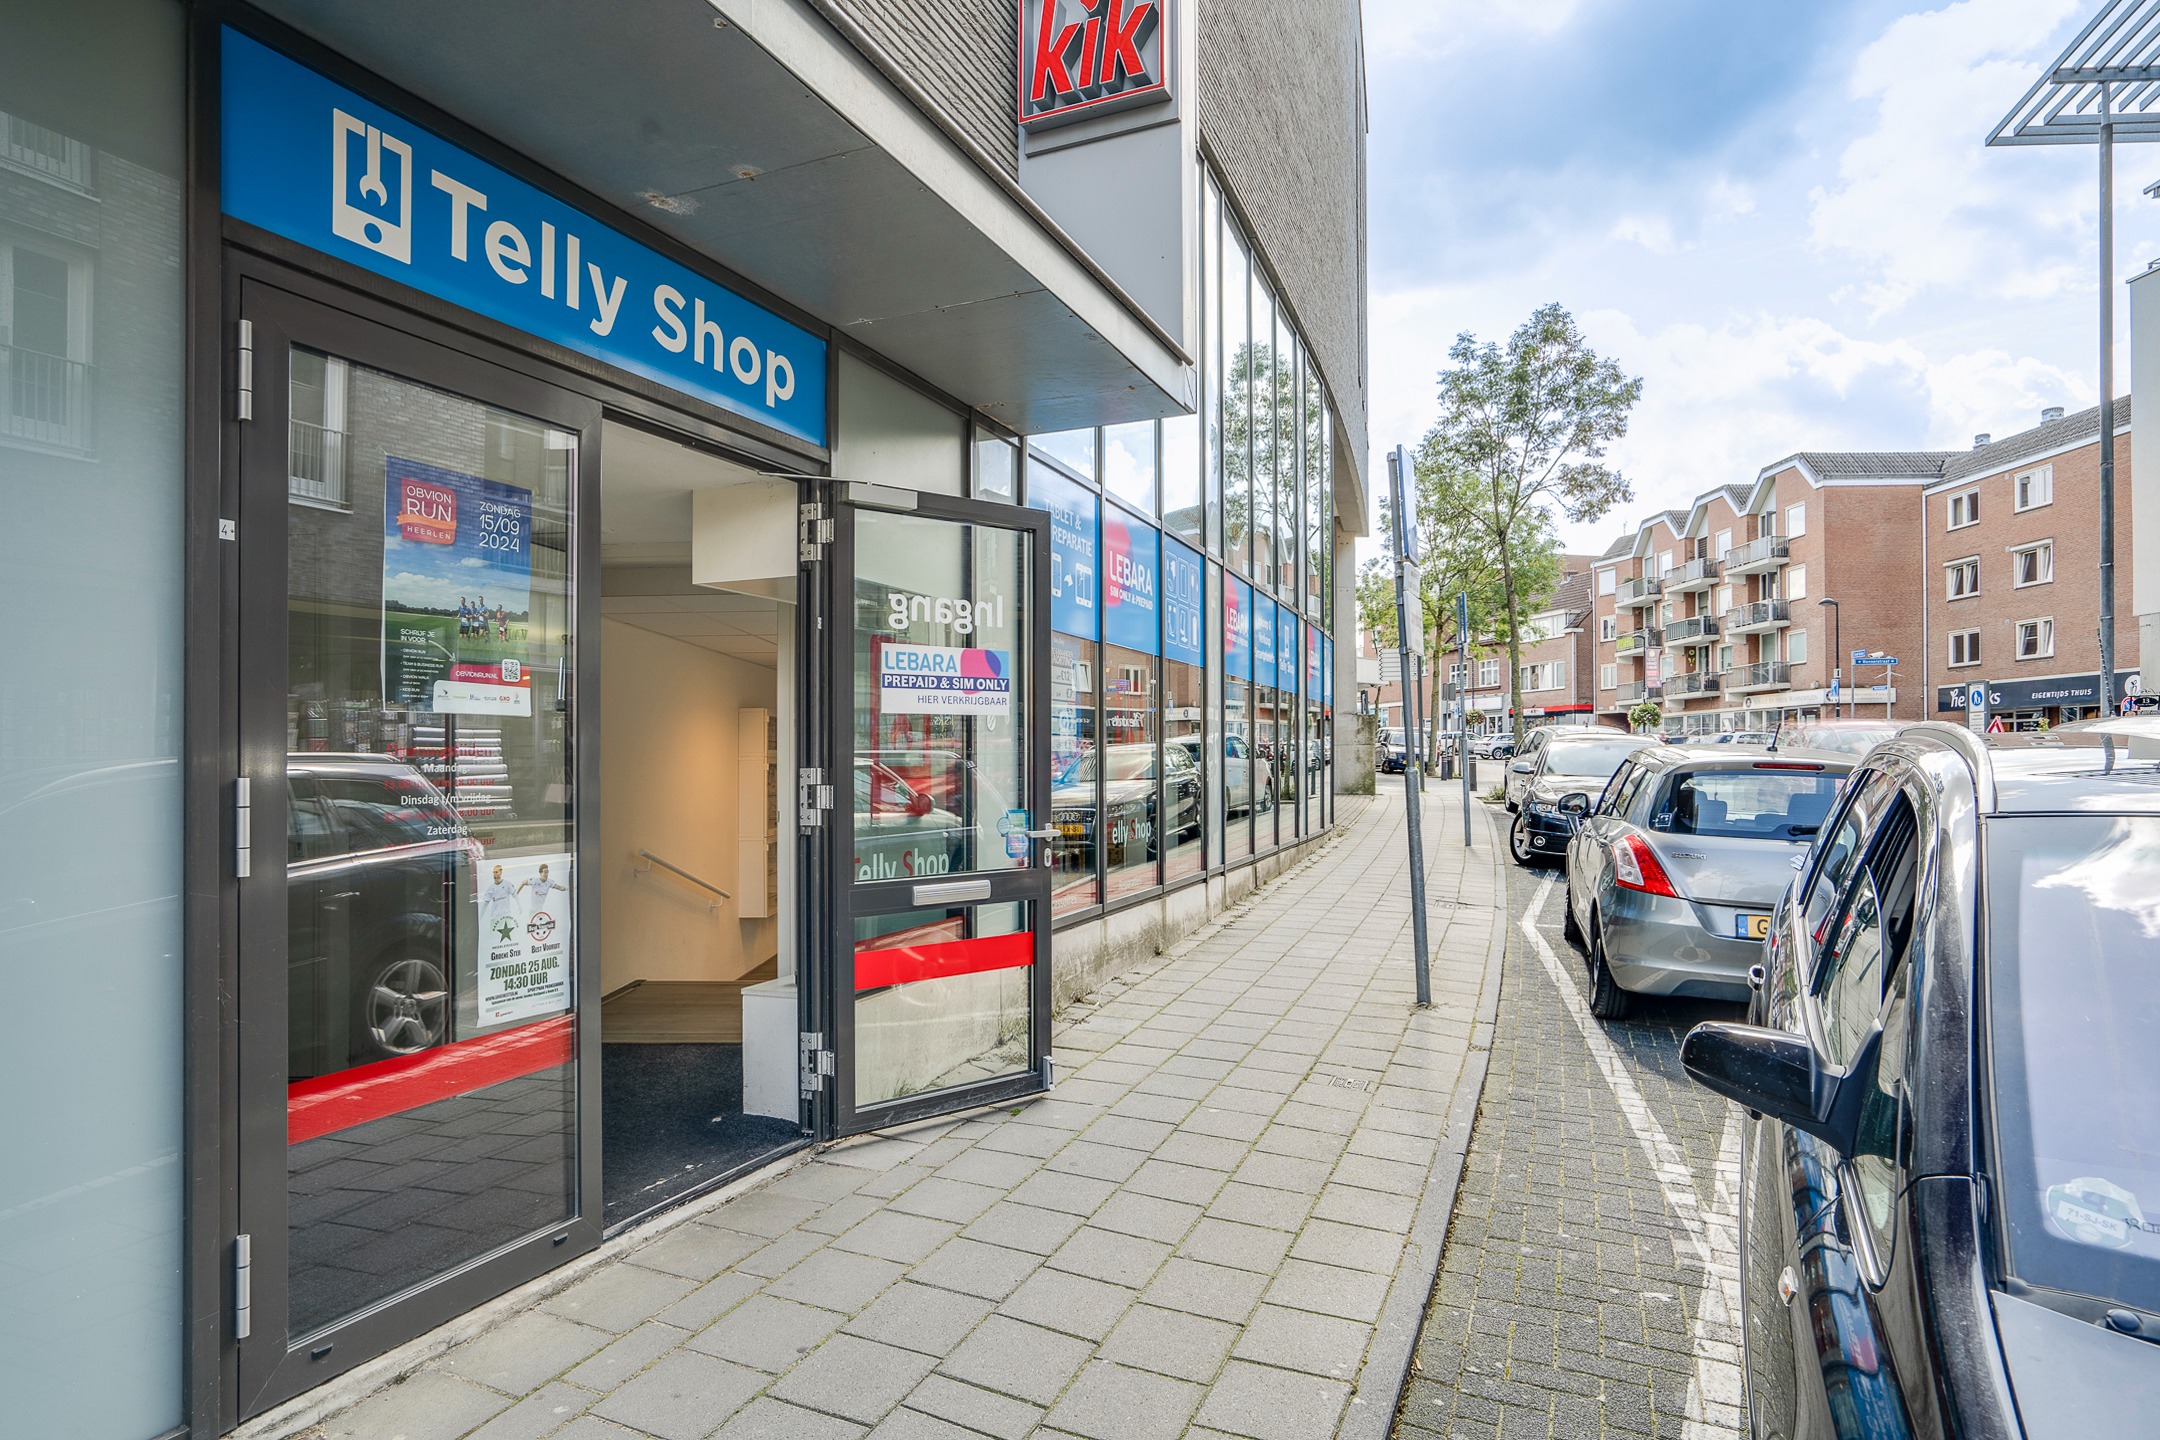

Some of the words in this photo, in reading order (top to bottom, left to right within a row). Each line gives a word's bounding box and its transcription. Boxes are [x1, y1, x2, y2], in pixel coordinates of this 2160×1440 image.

[431, 169, 628, 337] Telly
[652, 284, 796, 407] Shop
[406, 486, 452, 504] OBVION
[406, 499, 451, 522] RUN
[479, 501, 521, 518] ZONDAG
[407, 526, 451, 540] HEERLEN
[479, 514, 520, 535] 15/09
[479, 532, 520, 552] 2024
[1110, 550, 1153, 597] LEBARA
[884, 650, 958, 672] LEBARA
[884, 675, 938, 688] PREPAID
[939, 677, 950, 689] &
[952, 677, 974, 690] SIM
[976, 679, 1008, 691] ONLY
[917, 695, 939, 705] HIER
[941, 695, 1008, 706] VERKRIJGBAAR
[2031, 690, 2069, 699] EIGENTIJDS
[2071, 688, 2093, 697] THUIS
[400, 795, 439, 806] Dinsdag
[426, 824, 468, 836] Zaterdag
[1107, 820, 1129, 848] Telly
[1130, 817, 1152, 842] Shop
[1671, 852, 1707, 860] SUZUKI
[490, 962, 527, 980] ZONDAG
[528, 960, 540, 973] 25
[541, 956, 560, 971] AUG.
[503, 976, 528, 991] 14:30
[530, 972, 548, 986] UUR
[2067, 1208, 2118, 1232] 71-SJ-SK
